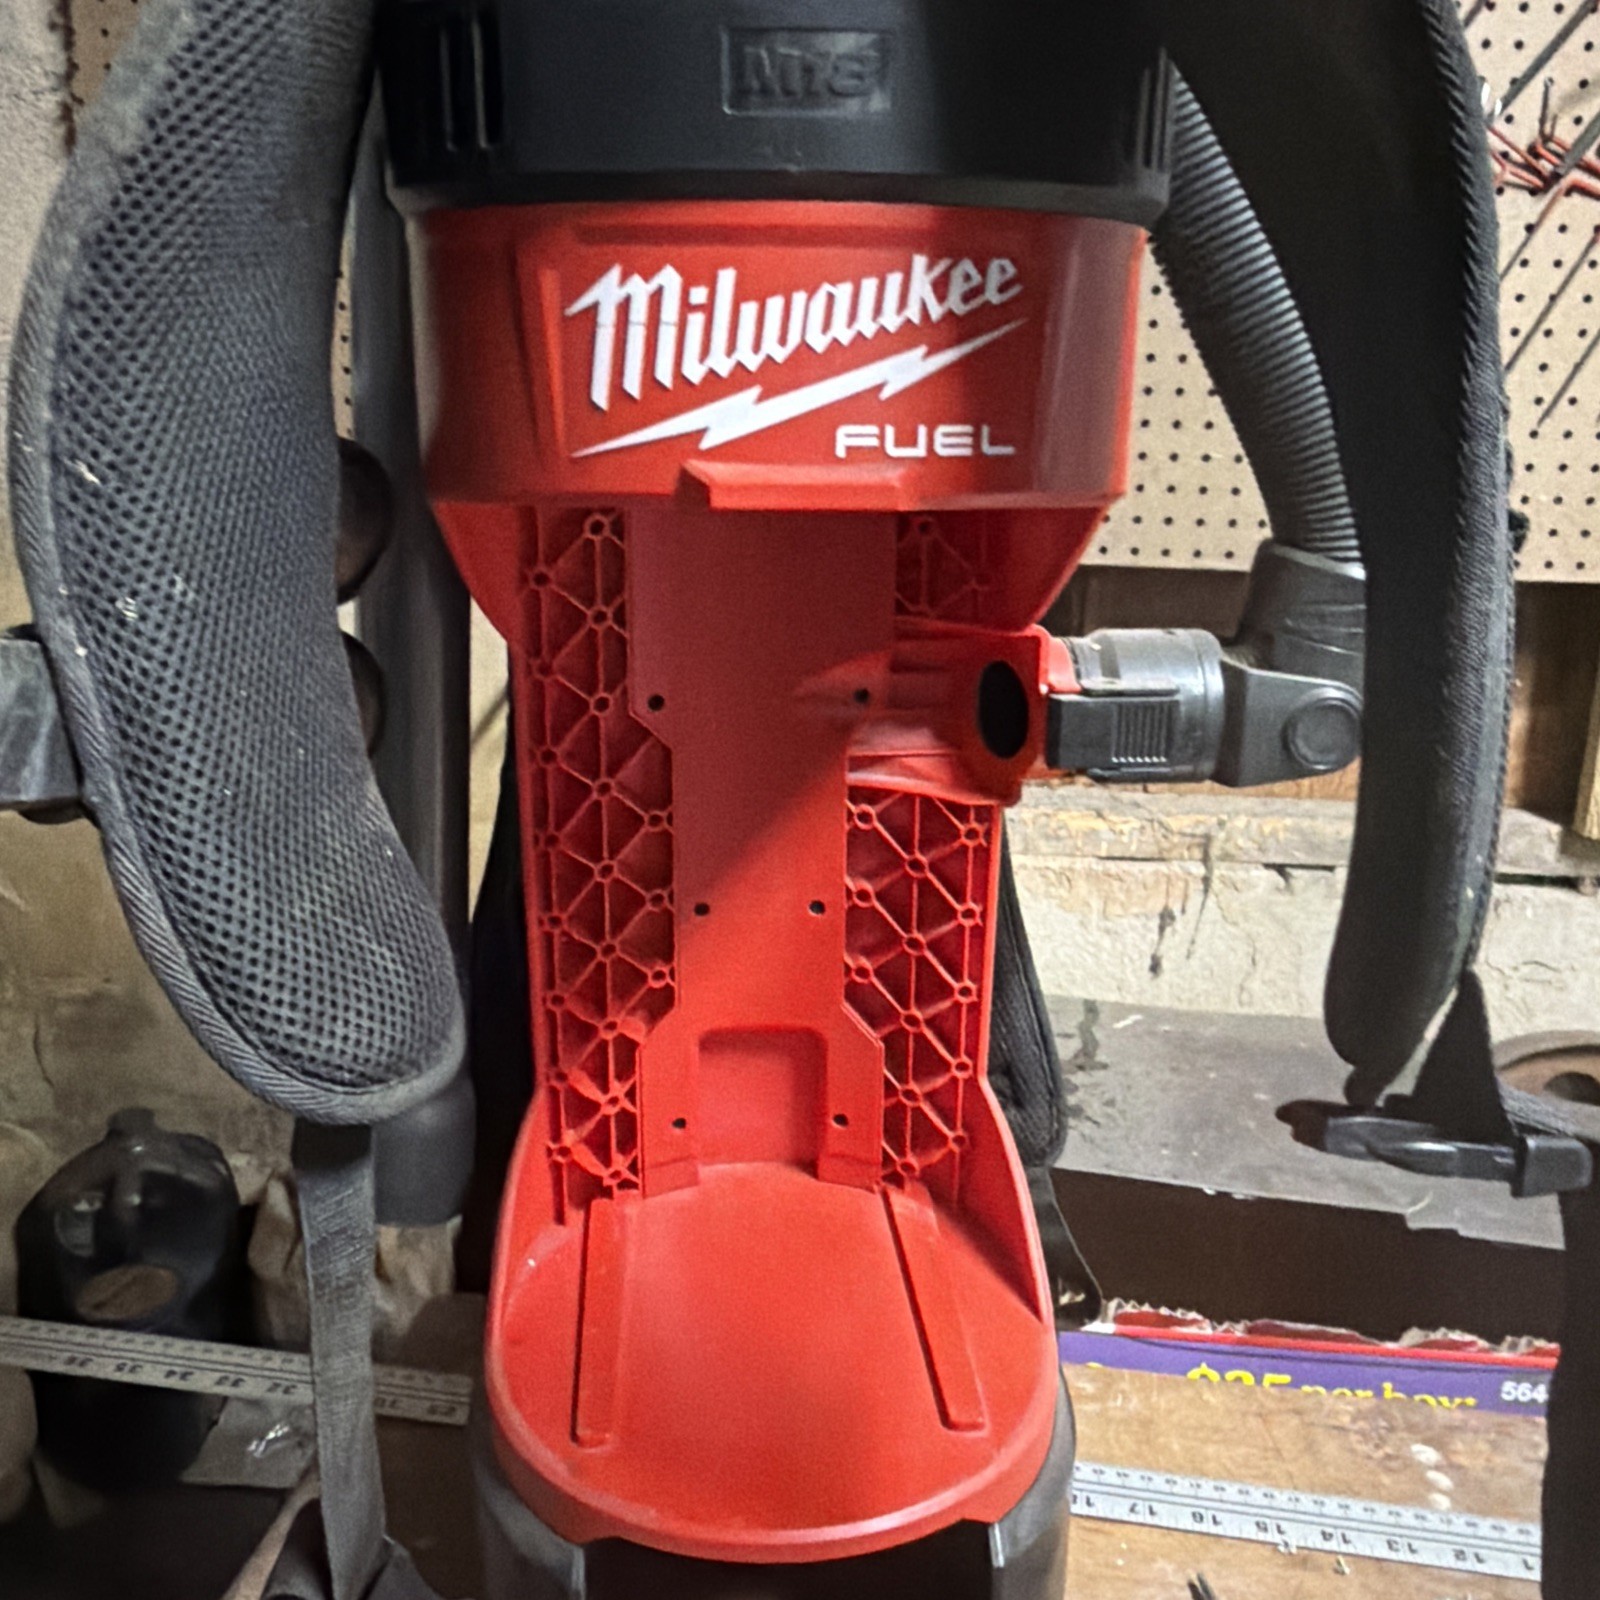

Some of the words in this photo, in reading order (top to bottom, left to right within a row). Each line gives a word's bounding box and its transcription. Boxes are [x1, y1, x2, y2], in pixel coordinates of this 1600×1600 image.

[564, 253, 1023, 412] Milwaukee
[835, 424, 1016, 458] FUEL
[1501, 1380, 1548, 1404] 564
[1129, 1502, 1157, 1517] 17
[1191, 1511, 1222, 1526] 16
[1255, 1520, 1286, 1535] 15
[1320, 1529, 1352, 1545] 14
[1386, 1539, 1418, 1555] 13
[1453, 1549, 1486, 1565] 12
